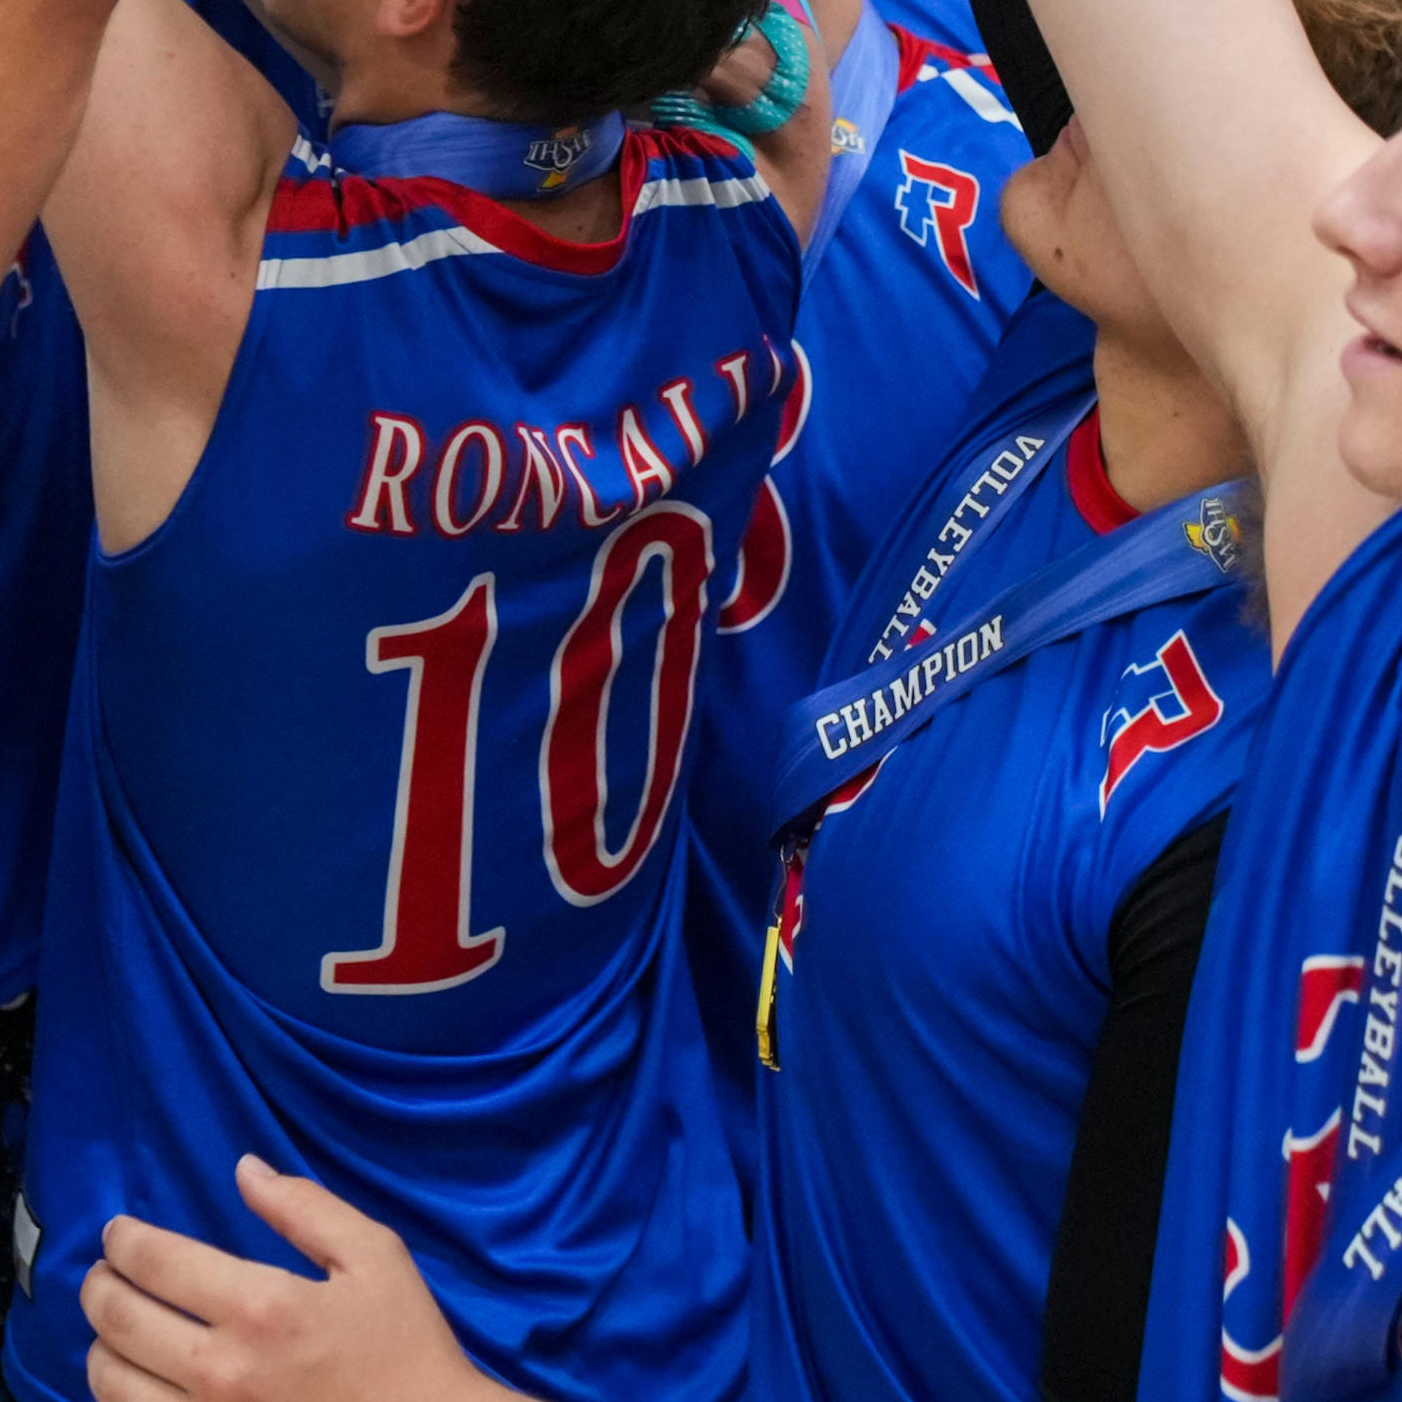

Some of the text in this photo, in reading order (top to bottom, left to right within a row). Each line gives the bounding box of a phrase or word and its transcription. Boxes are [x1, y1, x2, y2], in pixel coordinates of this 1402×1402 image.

[868, 435, 1046, 664] VOLLEYBALL
[320, 500, 715, 996] 10
[816, 614, 1005, 760] CHAMPION
